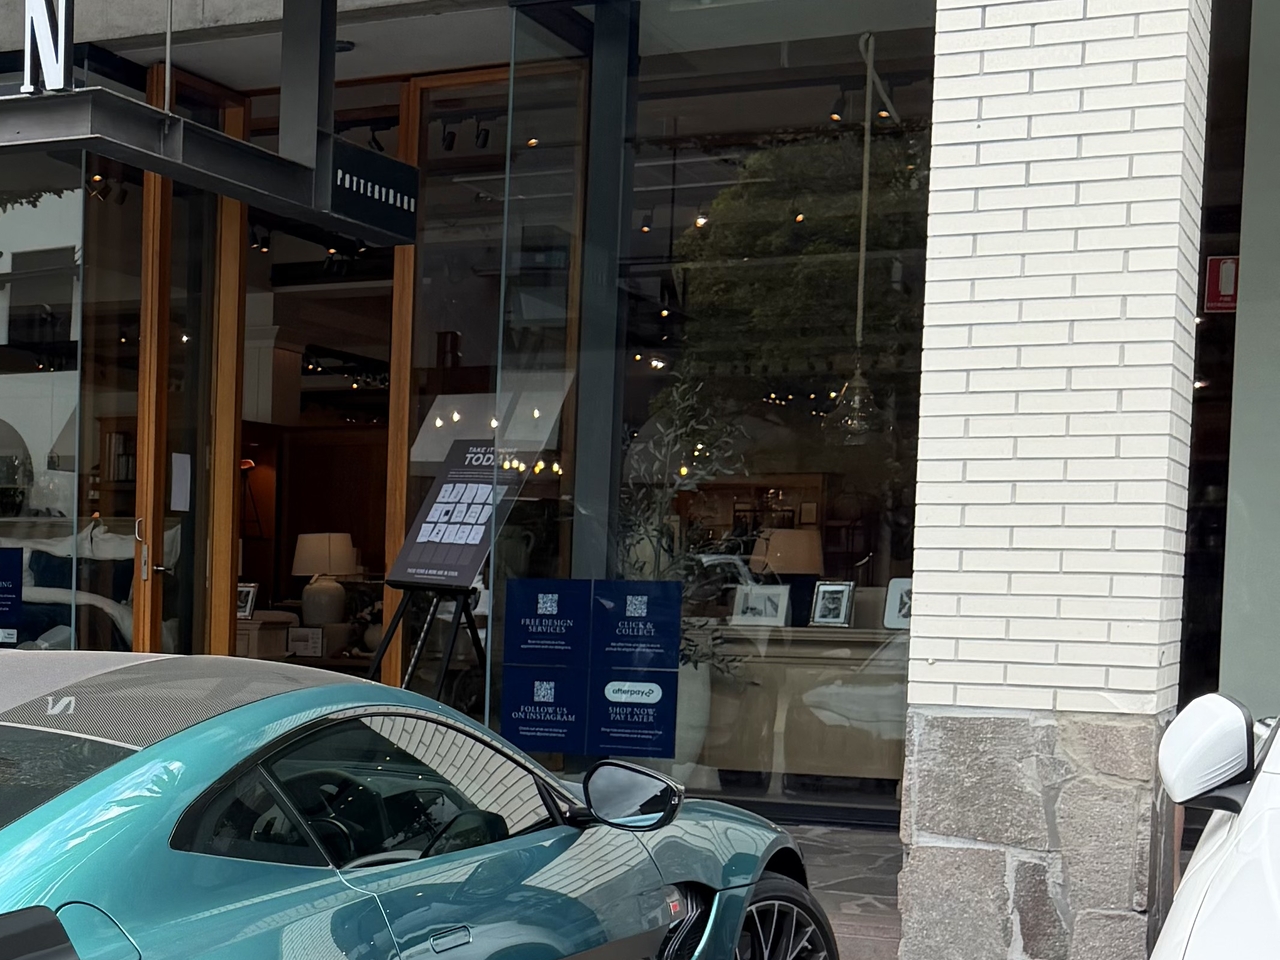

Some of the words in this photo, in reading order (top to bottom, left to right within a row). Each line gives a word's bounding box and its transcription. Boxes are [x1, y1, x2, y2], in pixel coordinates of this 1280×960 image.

[542, 618, 574, 626] DESIGN
[618, 621, 645, 629] CLICK
[646, 621, 654, 629] &
[528, 625, 566, 633] SERVICES
[615, 628, 656, 636] COLLECT
[612, 688, 645, 697] afterpay
[520, 705, 555, 713] FOLLOW
[608, 706, 632, 714] SHOP
[511, 711, 525, 719] ON
[526, 712, 576, 722] INSTAGRAM
[610, 713, 626, 721] PAY
[627, 714, 654, 722] LATER
